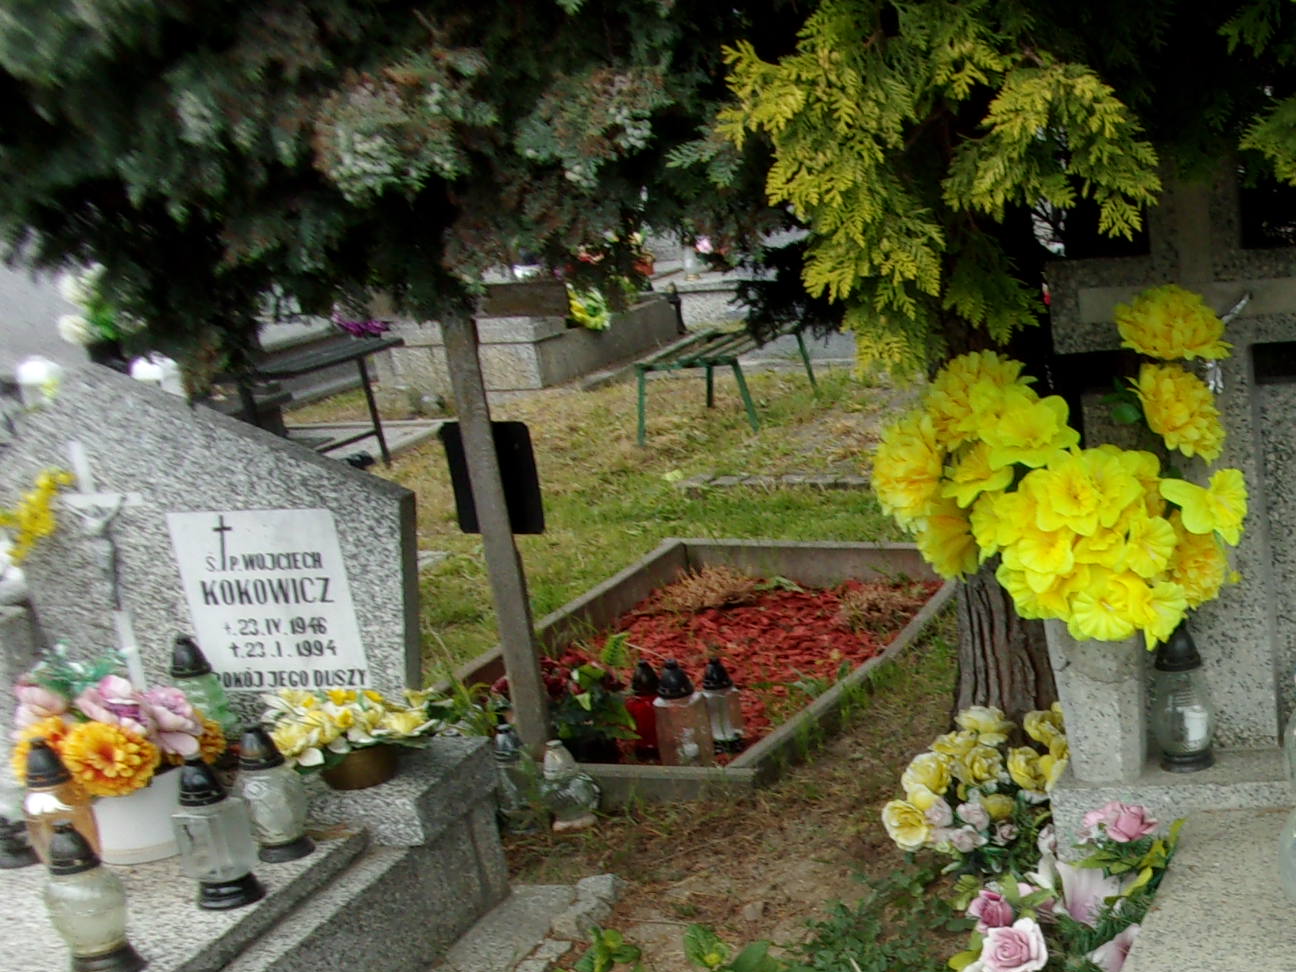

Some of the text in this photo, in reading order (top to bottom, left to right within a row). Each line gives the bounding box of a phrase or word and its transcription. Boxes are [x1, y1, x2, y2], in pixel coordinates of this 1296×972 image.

[243, 552, 324, 570] WOJCIECH
[200, 577, 336, 606] KOKOWICZ
[268, 669, 309, 687] JEGO
[313, 669, 367, 687] DUSZY
